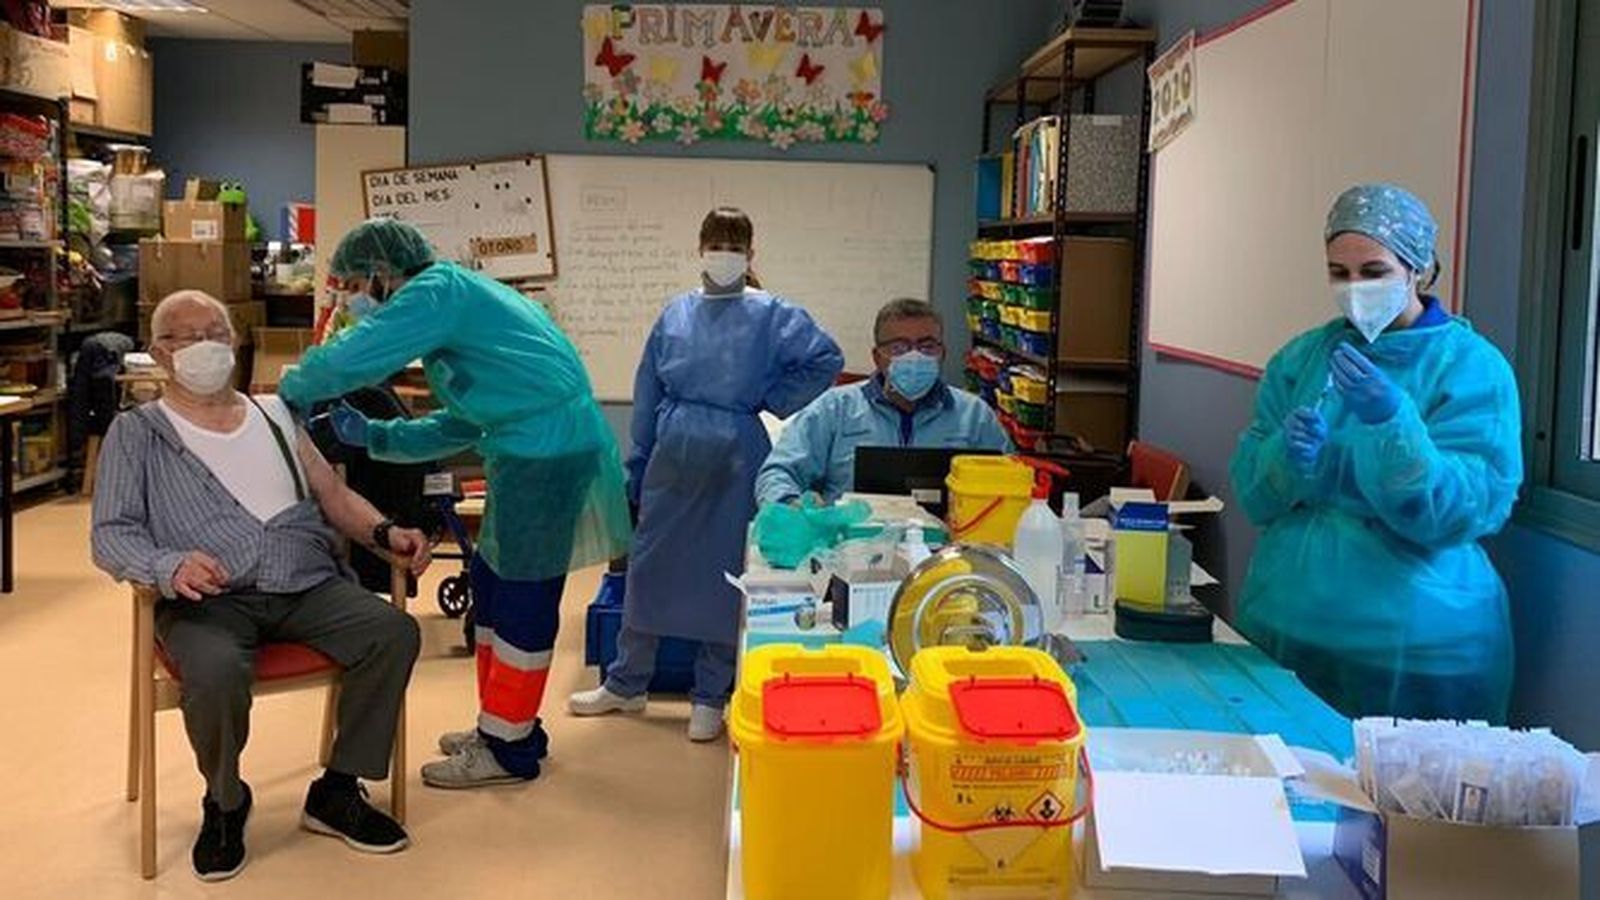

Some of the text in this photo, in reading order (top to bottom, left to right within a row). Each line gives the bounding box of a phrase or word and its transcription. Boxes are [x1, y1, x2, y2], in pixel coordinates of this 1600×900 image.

[611, 4, 854, 47] PRIMAVERA
[370, 169, 459, 188] DIA DE SEMANA
[372, 187, 451, 207] DIA DEL MES
